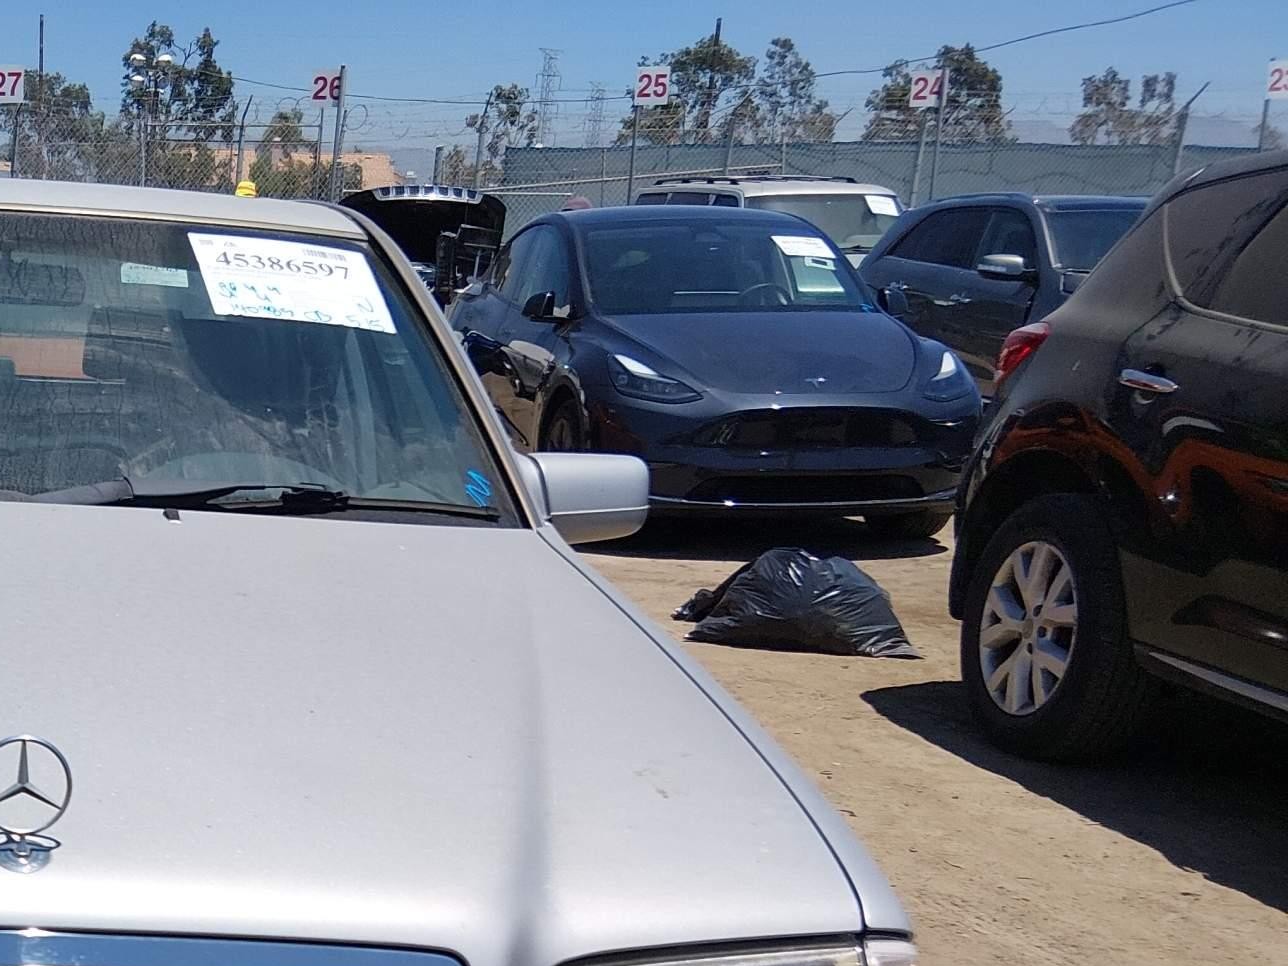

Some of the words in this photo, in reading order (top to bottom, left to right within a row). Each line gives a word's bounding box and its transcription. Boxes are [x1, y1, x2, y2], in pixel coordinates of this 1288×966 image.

[312, 76, 341, 100] 26
[637, 73, 668, 98] 25
[912, 76, 943, 101] 24
[215, 250, 349, 281] 45386597
